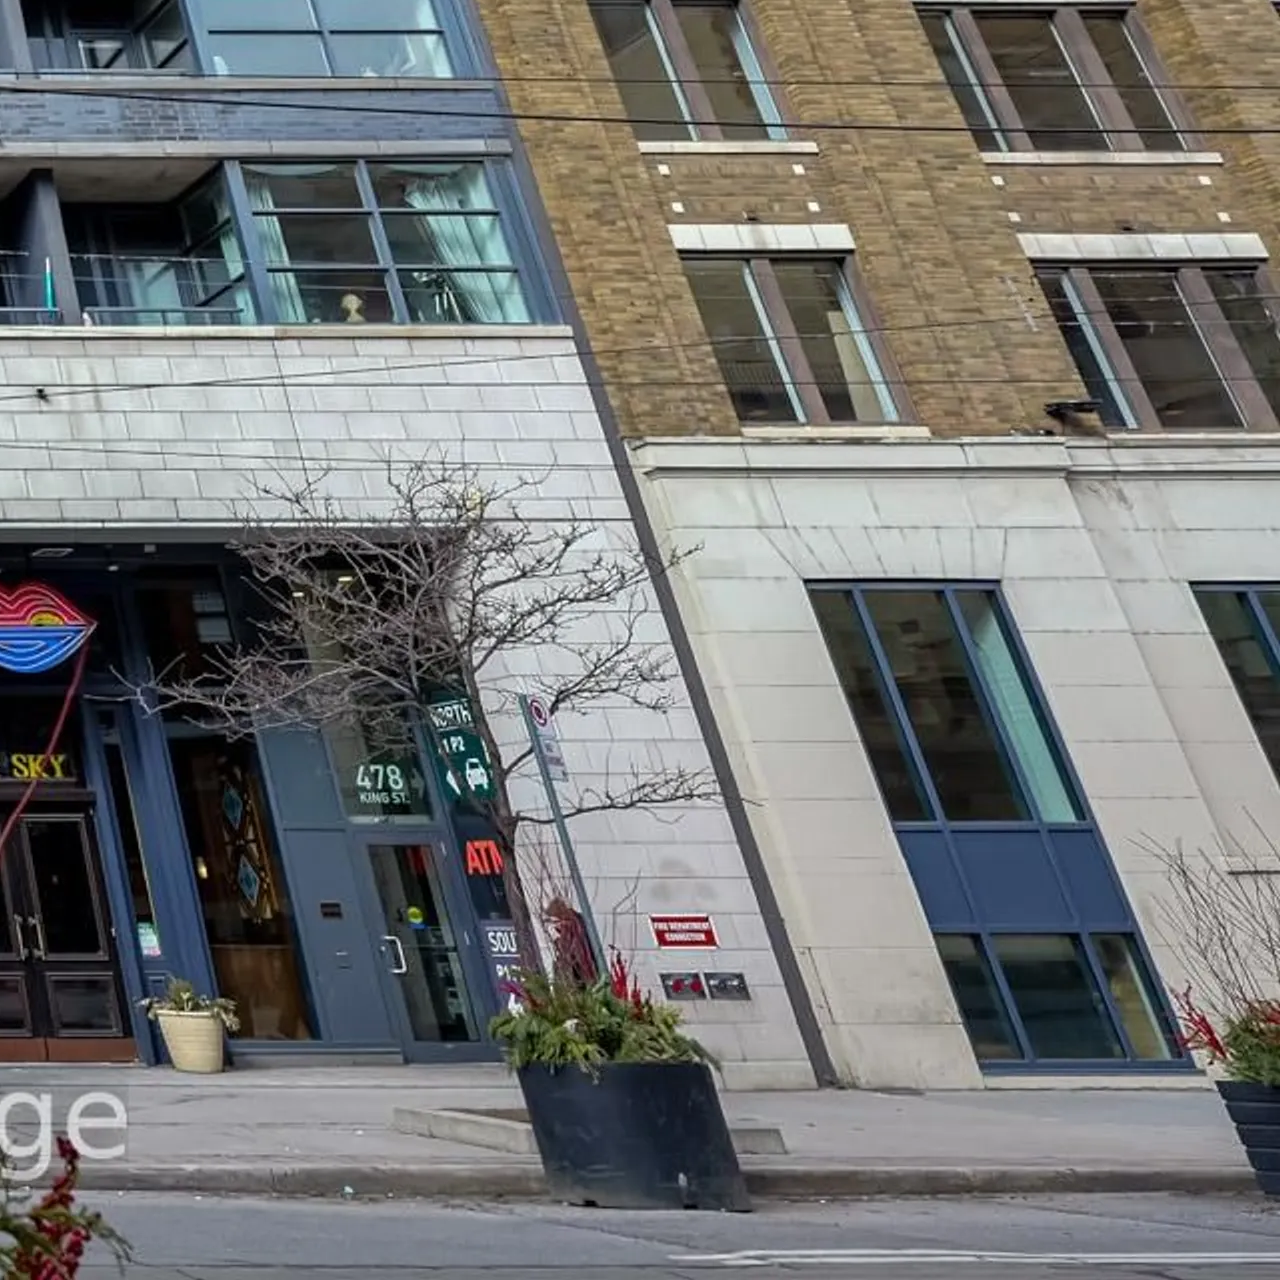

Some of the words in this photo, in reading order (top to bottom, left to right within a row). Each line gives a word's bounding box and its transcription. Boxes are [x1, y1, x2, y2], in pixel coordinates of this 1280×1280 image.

[10, 754, 66, 778] SKY
[356, 764, 403, 790] 478
[359, 791, 390, 804] KING
